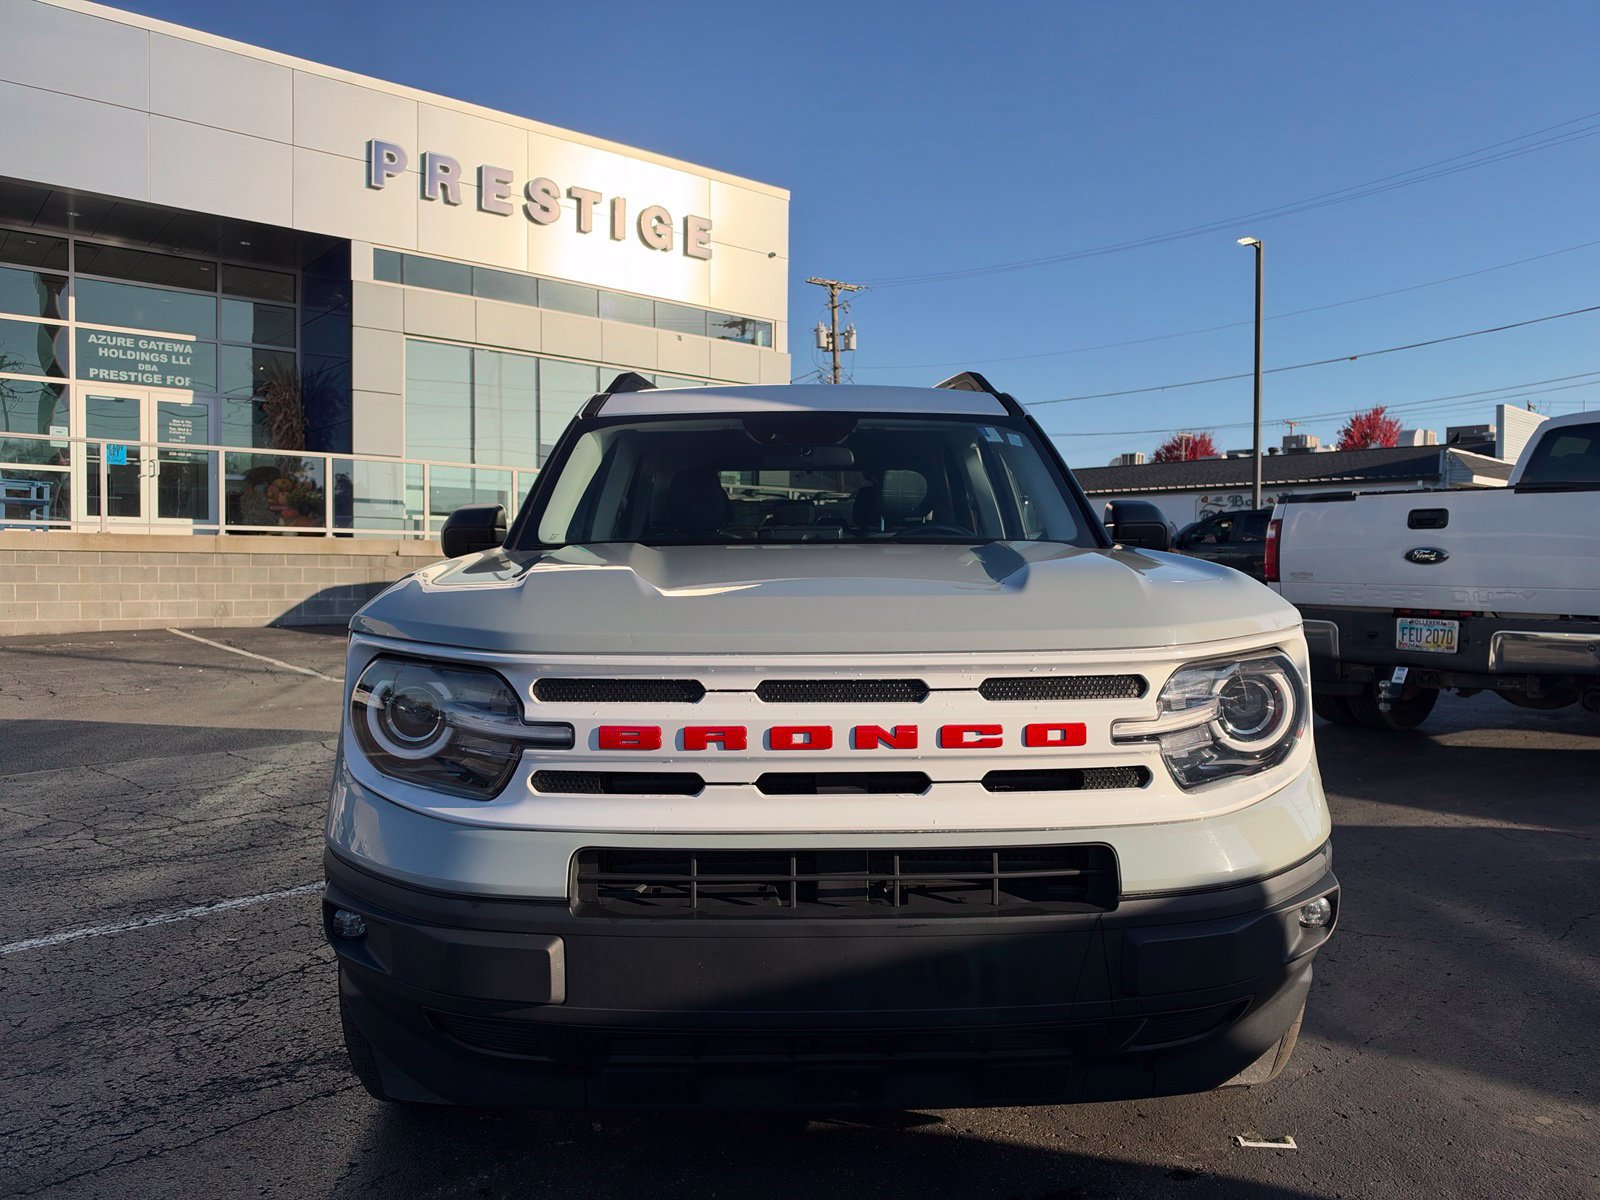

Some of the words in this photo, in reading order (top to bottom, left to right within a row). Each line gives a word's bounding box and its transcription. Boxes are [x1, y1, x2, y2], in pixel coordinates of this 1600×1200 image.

[366, 137, 713, 260] PRESTIGE
[88, 334, 135, 347] AZURE
[98, 347, 168, 363] HOLDINGS
[138, 363, 158, 372] DBA
[89, 368, 162, 384] PRESTIGE
[1411, 550, 1437, 561] Ford
[1329, 587, 1425, 603] SUPER
[1453, 590, 1541, 606] DUTY
[1401, 626, 1423, 643] FEU
[1425, 628, 1453, 645] 2070
[599, 722, 1087, 751] BRONCO
